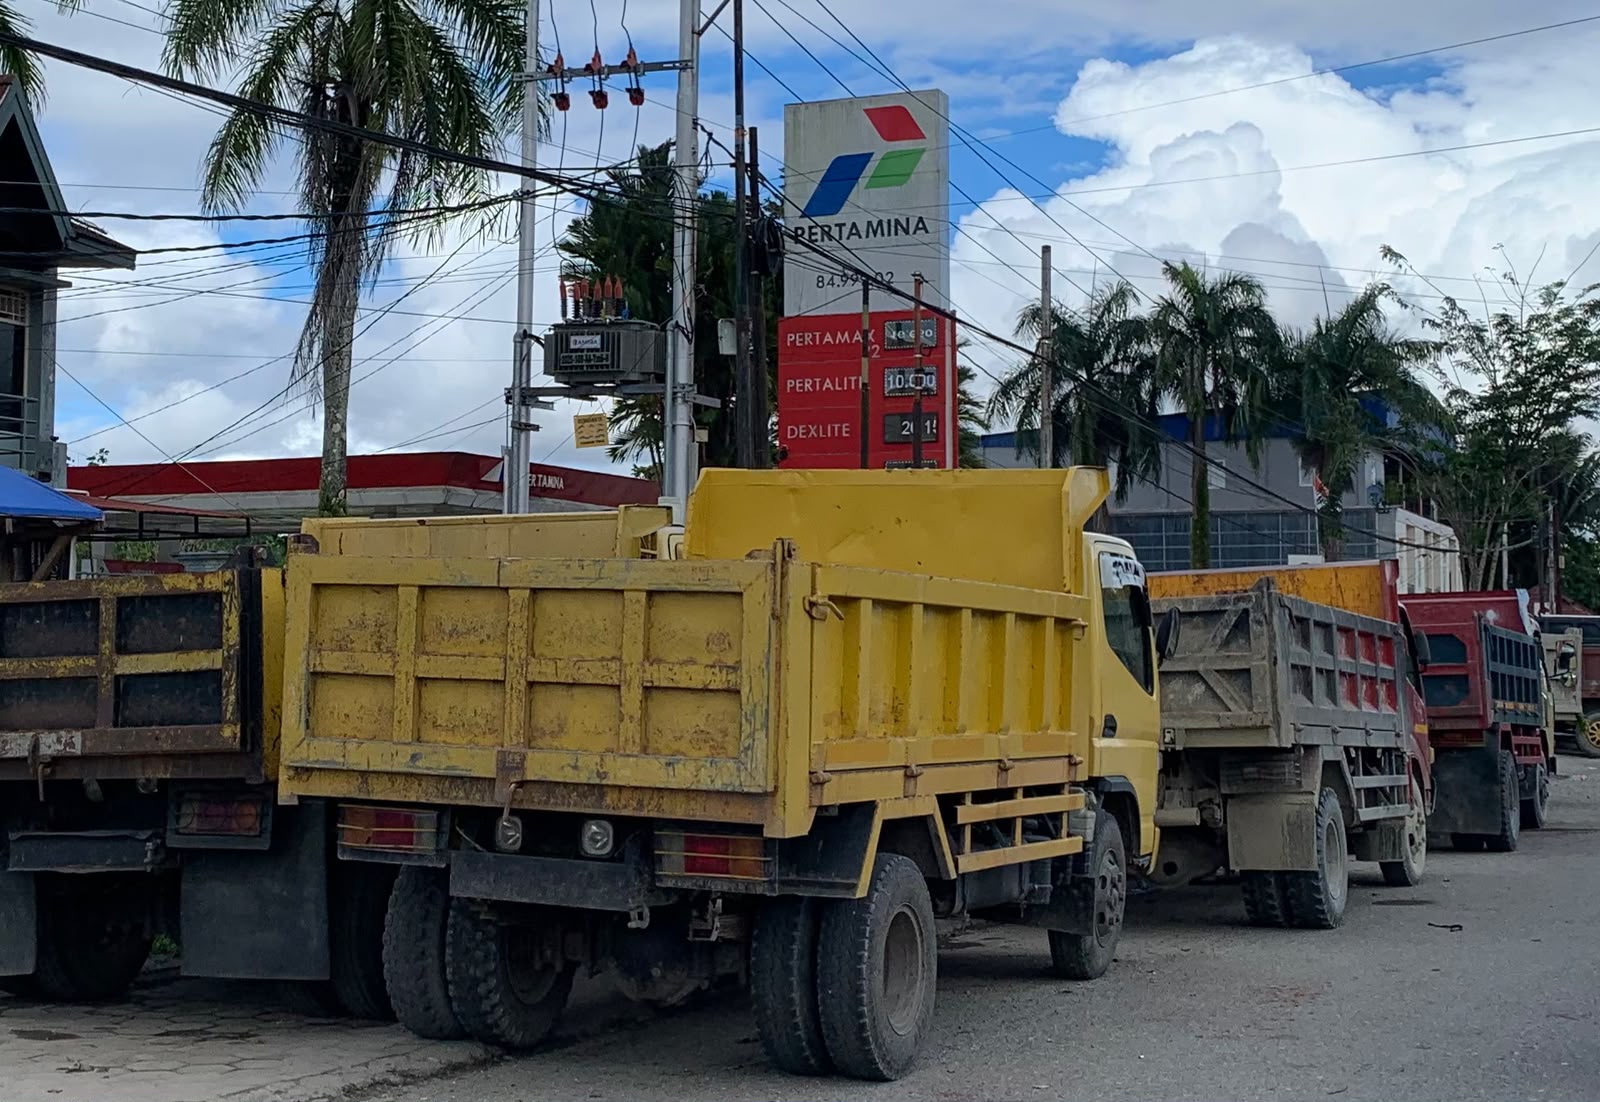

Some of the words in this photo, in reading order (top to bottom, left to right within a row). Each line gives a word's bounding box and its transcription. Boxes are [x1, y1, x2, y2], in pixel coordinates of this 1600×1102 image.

[793, 215, 930, 244] PERTAMINA
[786, 329, 876, 347] PERTAMAX
[867, 344, 881, 359] 2
[786, 376, 863, 393] PERTALIT
[786, 423, 851, 439] DEXLITE
[527, 473, 565, 490] ERTAMINA
